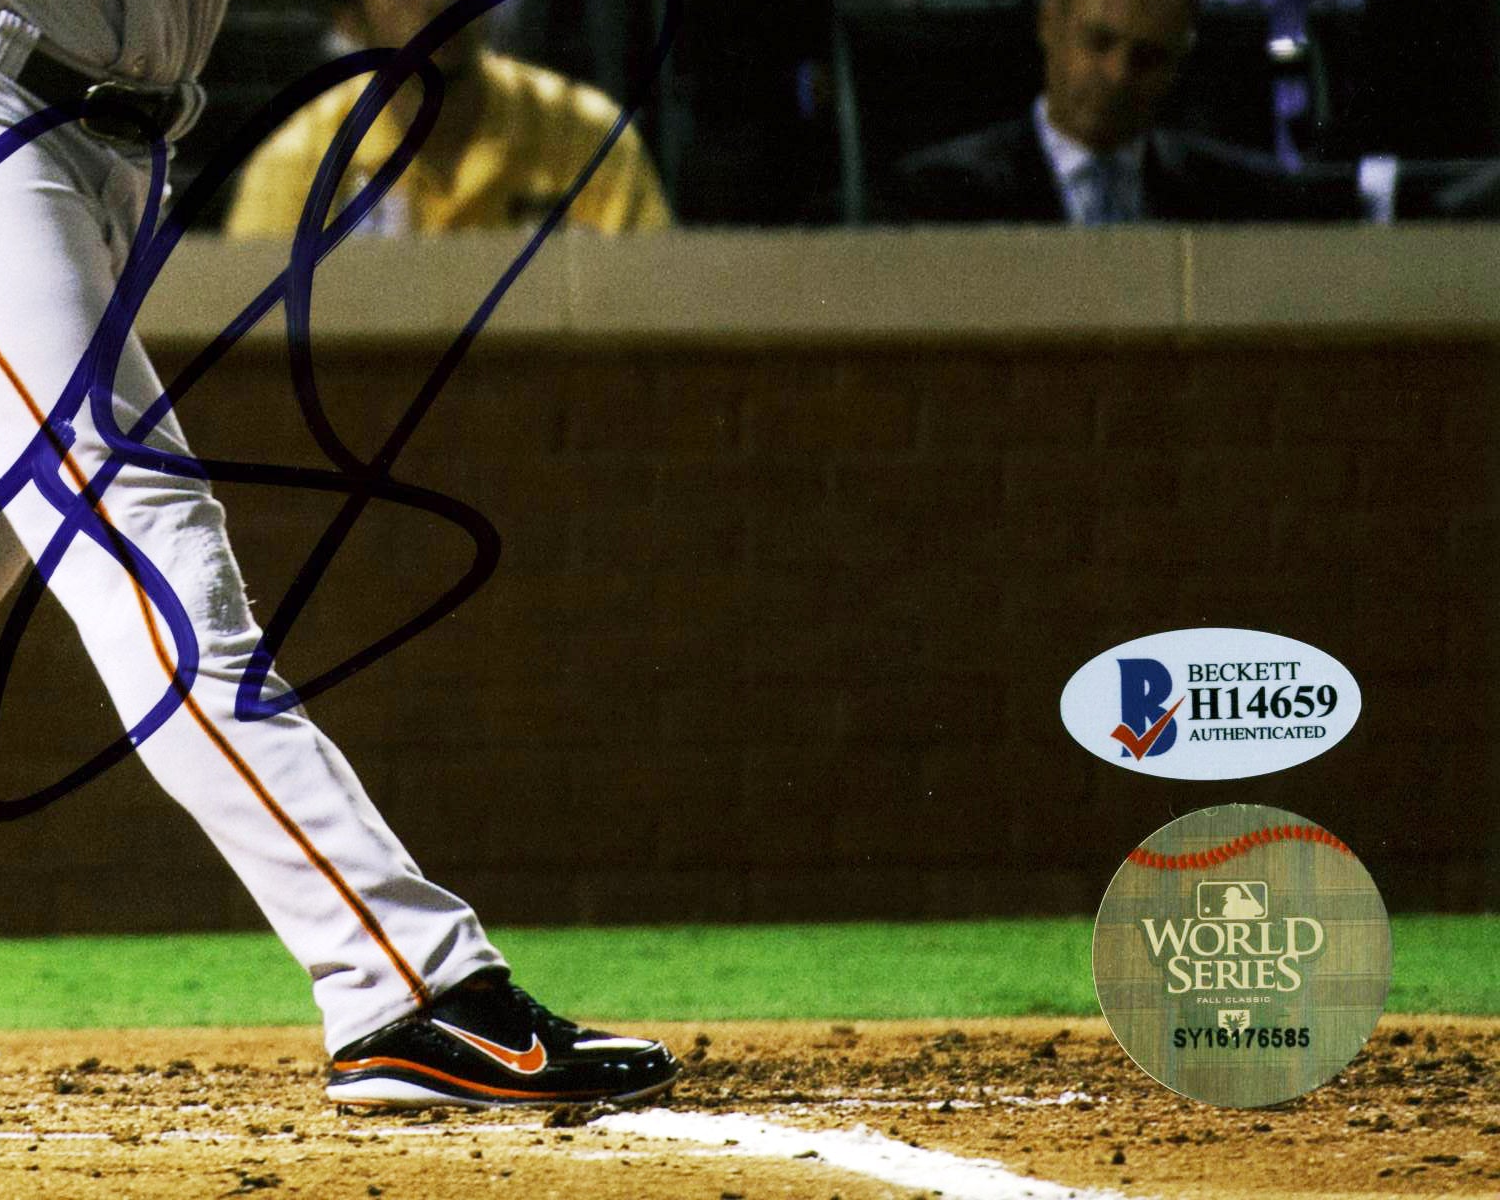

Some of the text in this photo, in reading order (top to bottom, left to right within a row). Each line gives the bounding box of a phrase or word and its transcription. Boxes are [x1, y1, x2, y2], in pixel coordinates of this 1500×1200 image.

[1188, 662, 1300, 682] BECKETT
[1187, 684, 1338, 720] H14659
[1189, 725, 1326, 741] AUTHENTICATED
[1141, 917, 1324, 957] WORLD
[1167, 954, 1302, 994] SERIES
[1197, 996, 1271, 1004] FALL CLASSIC
[1173, 1027, 1310, 1049] SY16176585
